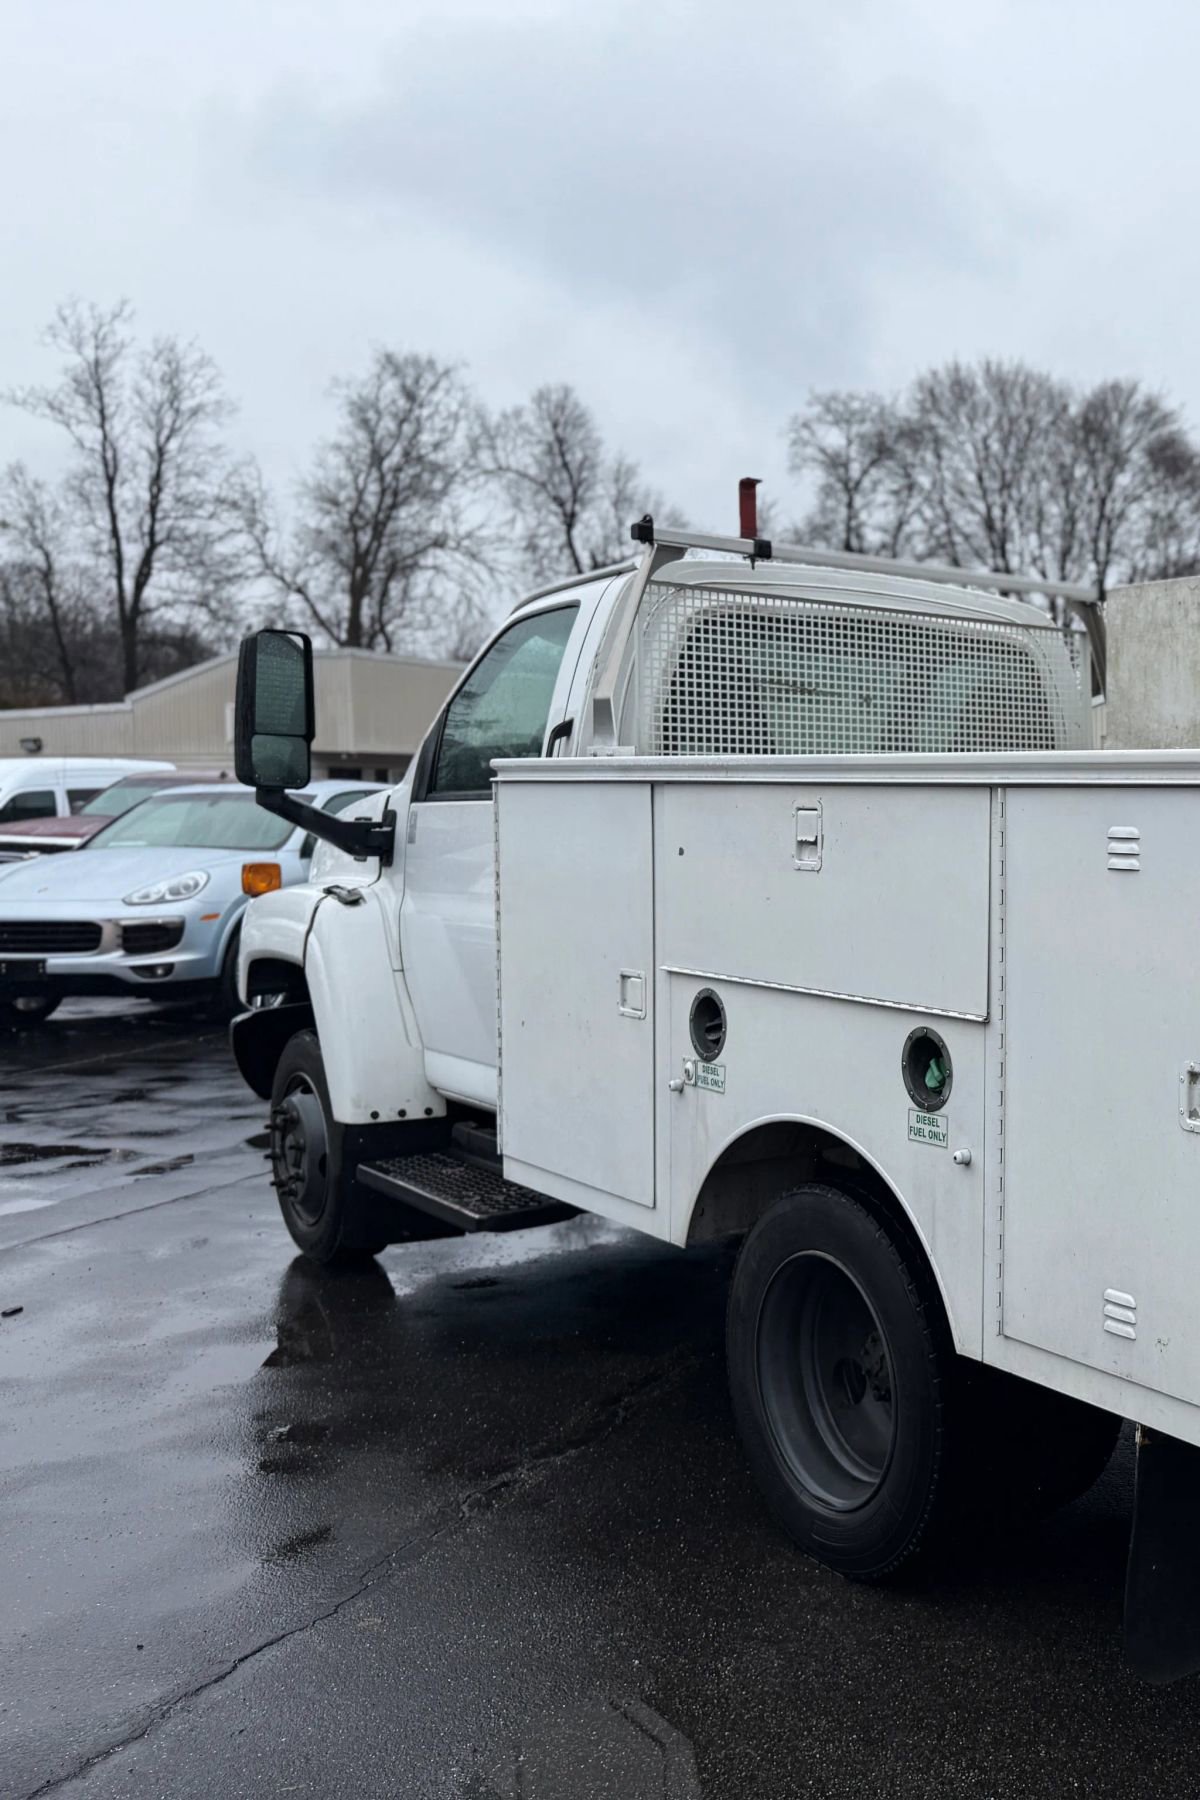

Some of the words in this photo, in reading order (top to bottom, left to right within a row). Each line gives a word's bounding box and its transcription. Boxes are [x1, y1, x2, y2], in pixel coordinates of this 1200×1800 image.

[702, 1065, 719, 1077] DIESEL
[698, 1074, 709, 1086] FUEL
[711, 1078, 725, 1088] ONLY
[916, 1114, 940, 1128] DIESEL
[910, 1126, 926, 1138] FUEL
[928, 1130, 947, 1142] ONLY
